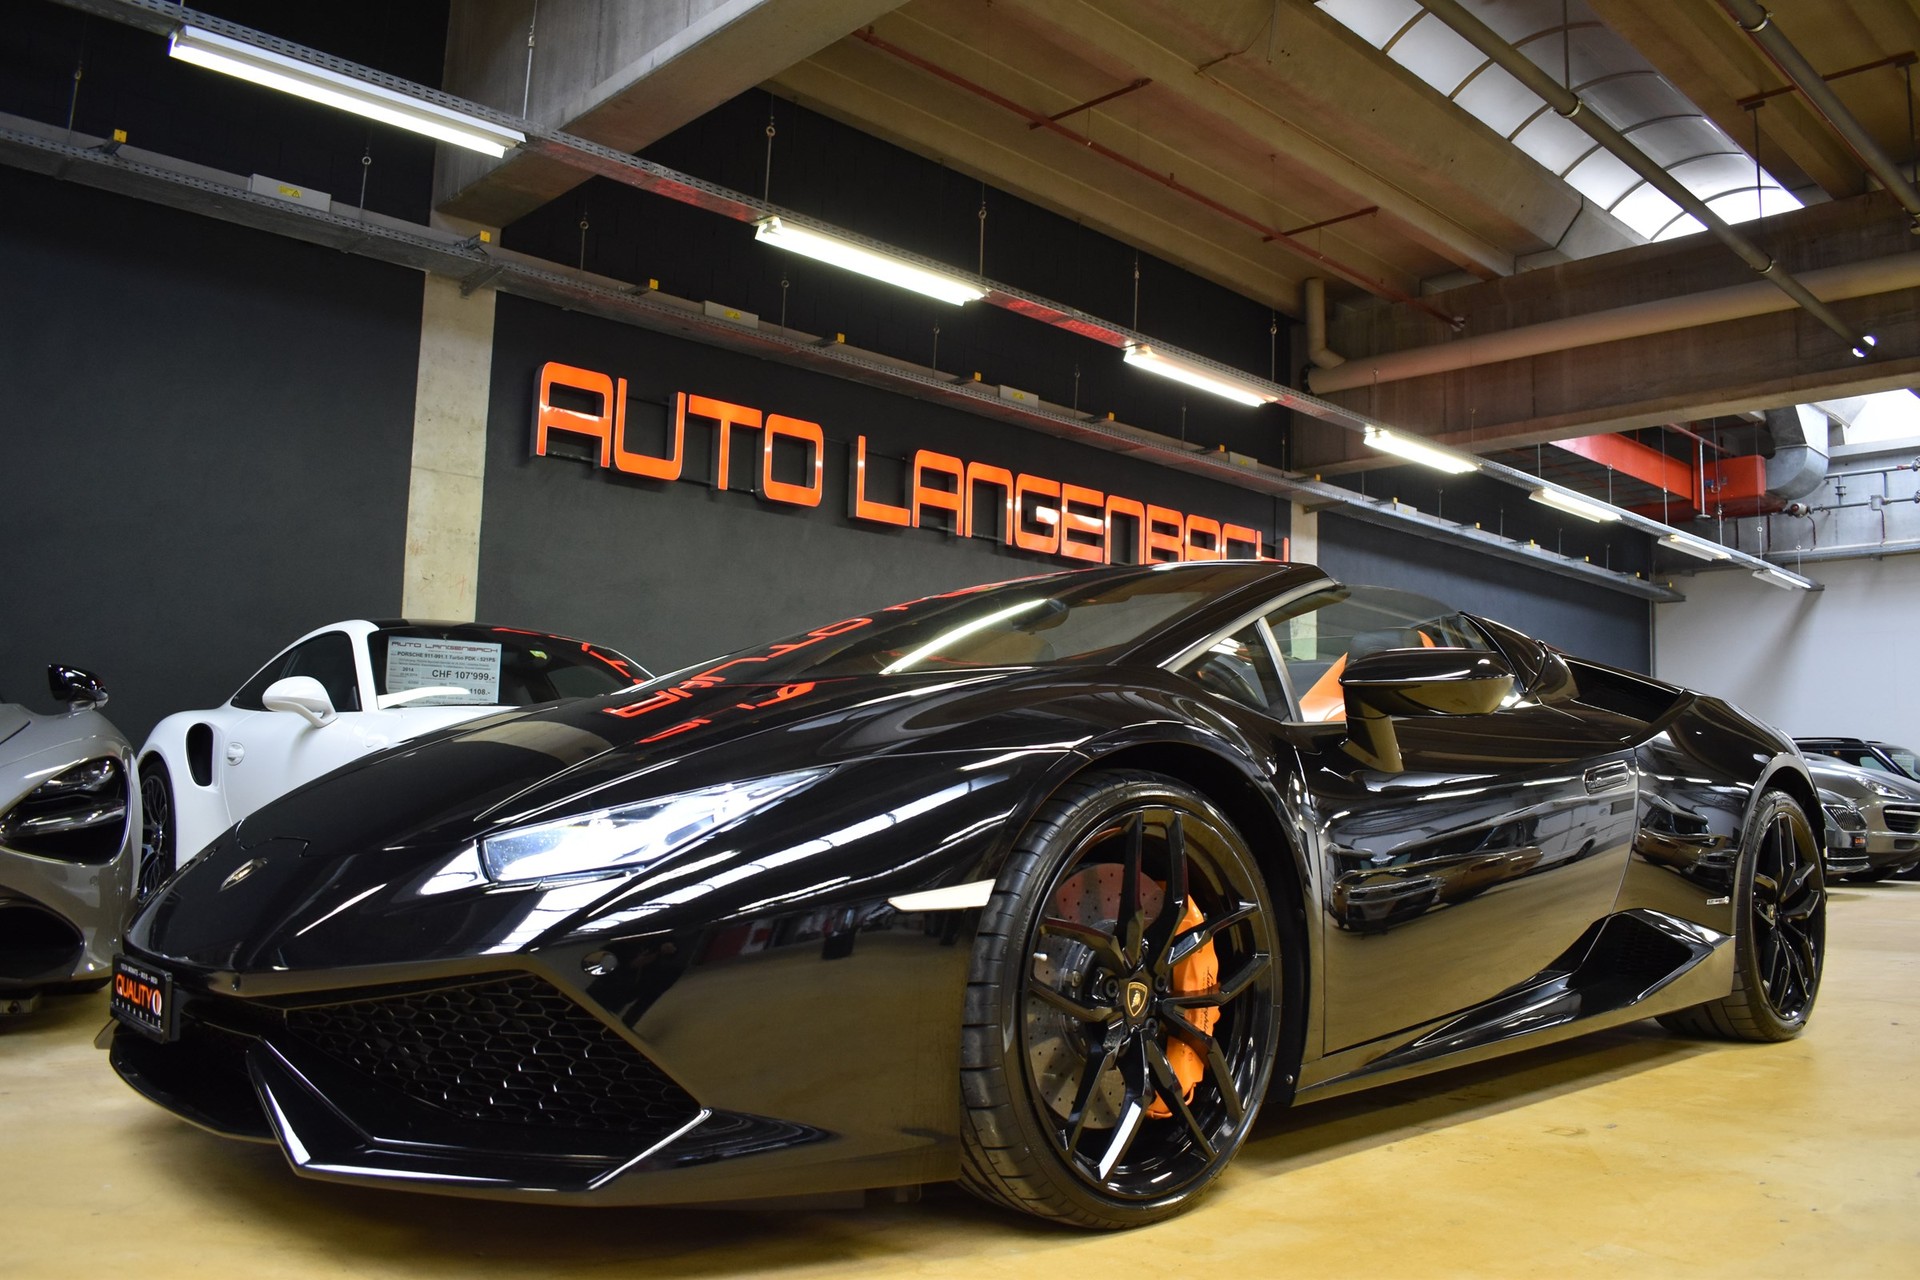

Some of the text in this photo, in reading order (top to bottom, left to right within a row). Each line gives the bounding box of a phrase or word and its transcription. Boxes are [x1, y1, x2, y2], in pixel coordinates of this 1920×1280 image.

[537, 362, 823, 507] AUTO
[425, 643, 498, 653] LANGENBACH
[431, 669, 452, 679] CHF
[455, 671, 496, 681] 107'999.-
